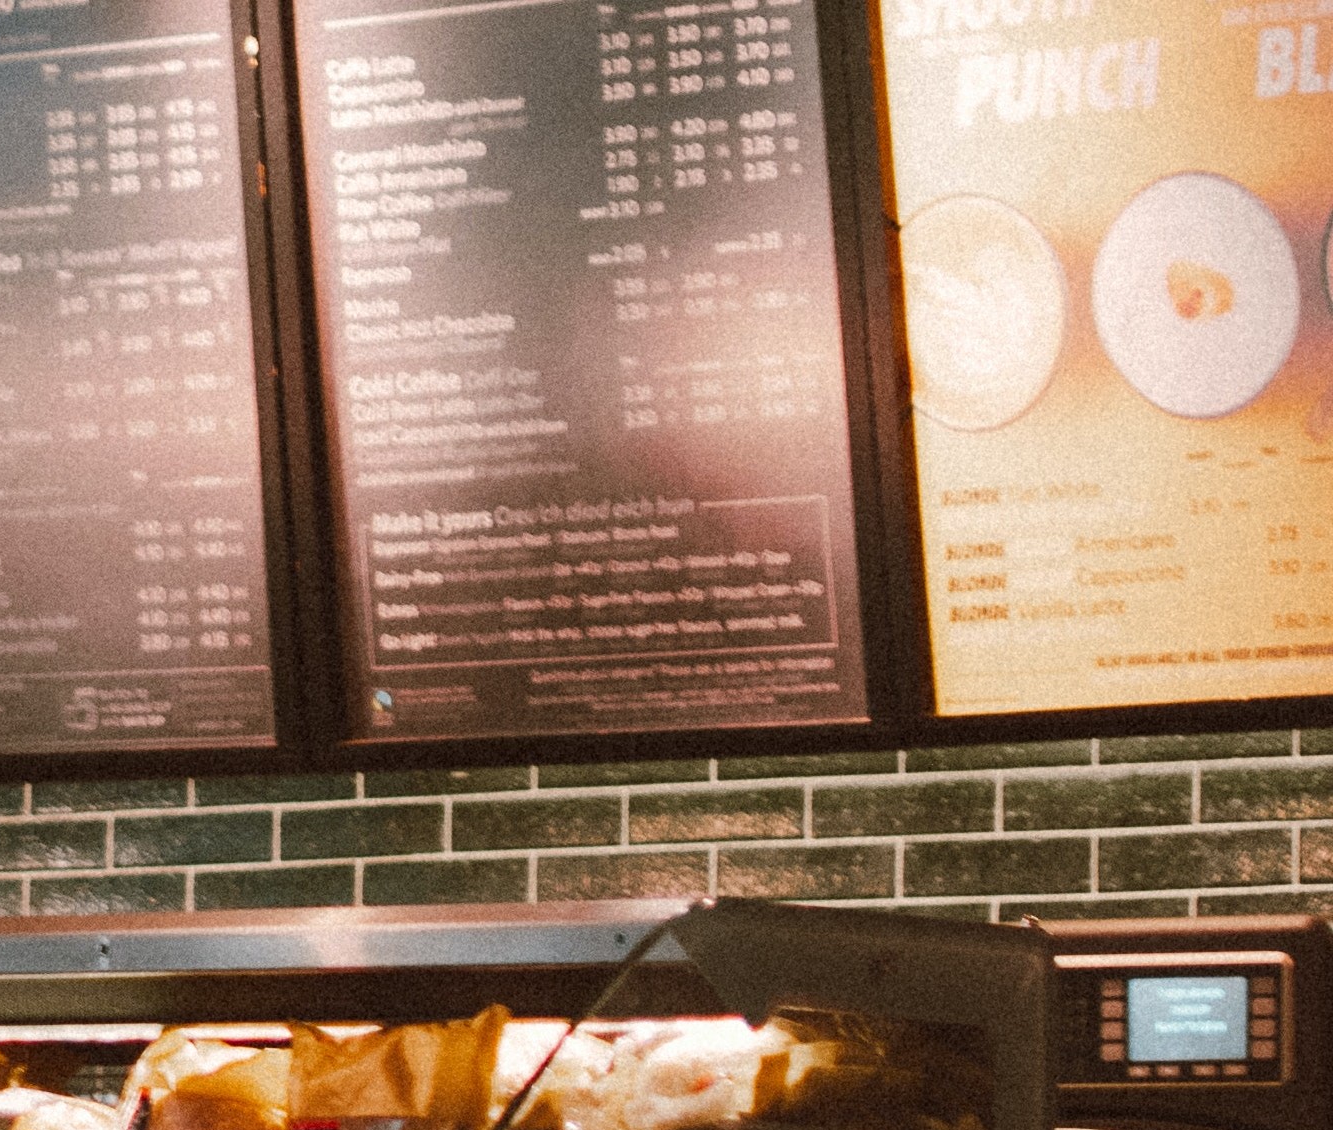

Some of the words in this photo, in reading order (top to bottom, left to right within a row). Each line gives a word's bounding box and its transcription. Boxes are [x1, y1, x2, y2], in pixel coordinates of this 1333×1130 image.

[952, 36, 1160, 129] PUNCH
[1254, 21, 1333, 99] BL
[395, 369, 463, 395] Coffee
[371, 511, 422, 534] Make
[439, 510, 493, 536] yours
